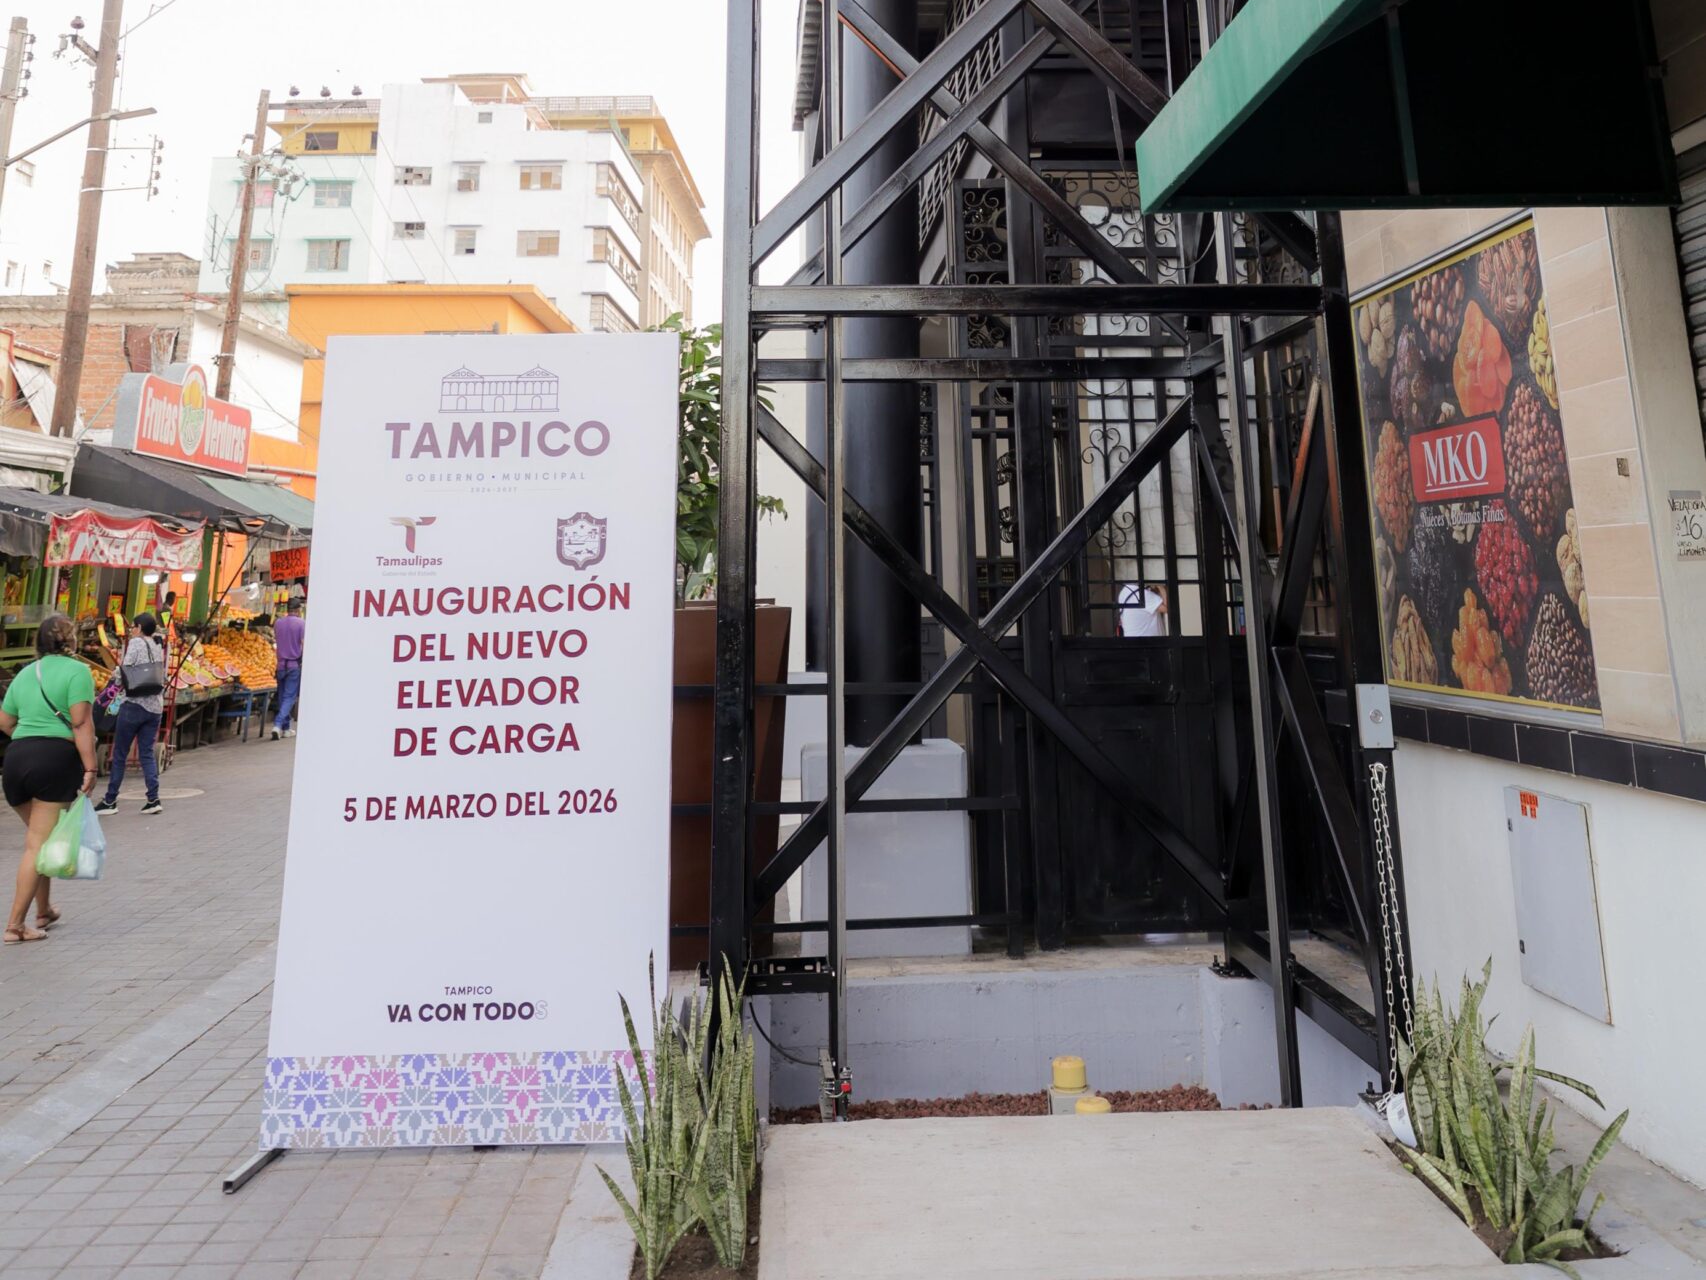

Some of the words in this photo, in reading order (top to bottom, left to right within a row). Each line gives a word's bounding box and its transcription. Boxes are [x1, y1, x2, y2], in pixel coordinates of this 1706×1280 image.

[142, 386, 178, 447] Frutas
[203, 408, 246, 465] Verduras
[384, 420, 611, 460] TAMPICO
[1421, 430, 1488, 487] MKO
[405, 473, 485, 482] GOBIERNO
[502, 471, 586, 481] MUNICIPAL
[1420, 509, 1444, 527] Nueces
[1451, 509, 1481, 525] Botanas
[1482, 505, 1505, 523] Finas
[70, 532, 181, 569] MORALES
[376, 555, 443, 568] Tamaulipas
[352, 575, 631, 618] INAUGURACIÓN
[392, 632, 455, 663] DEL
[467, 628, 588, 660] NUEVO
[396, 675, 580, 710] ELEVADOR
[393, 727, 437, 757] DE
[449, 722, 580, 755] CARGA
[344, 798, 357, 822] 5
[365, 796, 397, 821] DE
[404, 793, 497, 820] MARZO
[505, 791, 550, 817] DEL
[557, 788, 618, 815] 2026
[444, 985, 493, 995] TAMPICO
[387, 1004, 413, 1023] VA
[418, 1002, 467, 1022] CON
